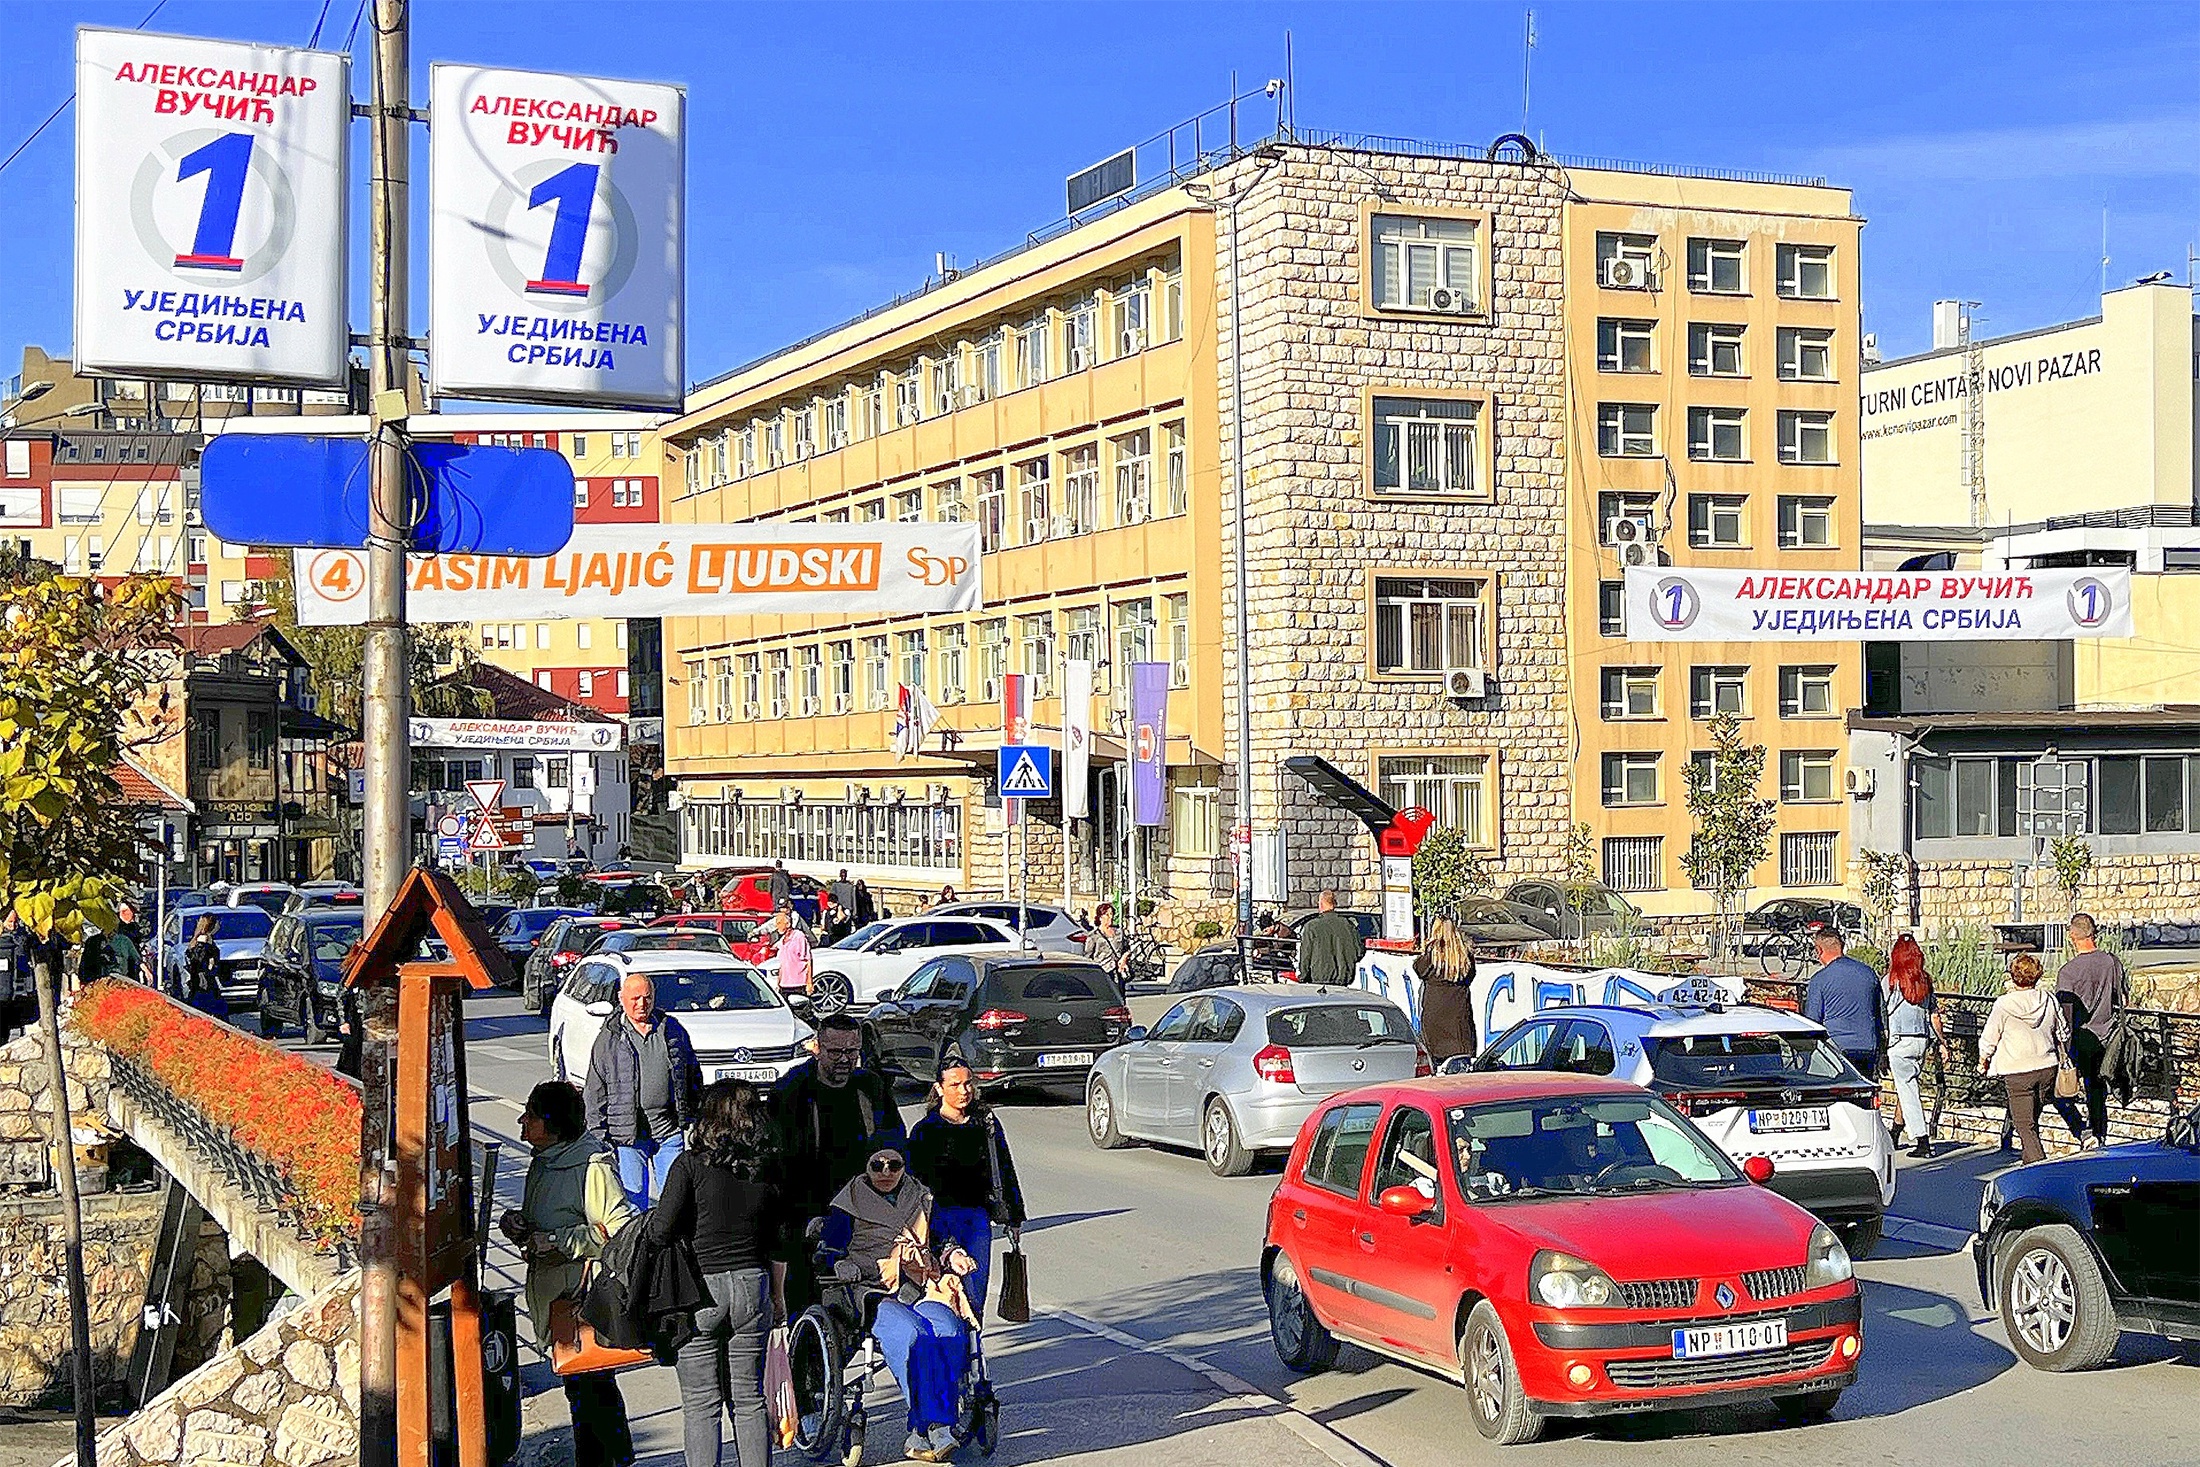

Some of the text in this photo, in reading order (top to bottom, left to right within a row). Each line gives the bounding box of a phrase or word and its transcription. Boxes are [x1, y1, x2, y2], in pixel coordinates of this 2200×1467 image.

[116, 61, 317, 97] АЛЕКСАНДАР
[154, 88, 275, 124] ВУЧИЋ
[471, 95, 658, 129] АЛЕКСАНДАР
[507, 120, 619, 155] ВУЧИЋ
[174, 132, 255, 272] 1
[524, 162, 601, 297] 1
[124, 289, 306, 324] УЈЕДИЊЕНА
[155, 319, 271, 348] СРБИЈА
[478, 313, 648, 347] УЈЕДИЊЕНА
[507, 343, 615, 370] СРБИЈА
[1911, 372, 1982, 406] CENTAR
[1988, 362, 2031, 393] NOVI
[2037, 349, 2101, 383] PAZAR
[542, 541, 675, 597] LJAJIĆ
[695, 547, 874, 594] LJUDSKI
[906, 547, 968, 586] SDP
[1664, 585, 1684, 625] 1
[1736, 576, 2033, 604] АЛЕКСАНДАР ВУЧИЋ
[2081, 584, 2099, 624] 1
[1752, 609, 2022, 633] УЈЕДИЊЕНА СРБИЈА
[449, 722, 533, 735] АЛЕКСАНДАР
[528, 736, 571, 746] СРБИЈА
[1672, 989, 1729, 1003] 42-42-42
[1758, 1111, 1773, 1127] NP
[1688, 1332, 1711, 1353] NP
